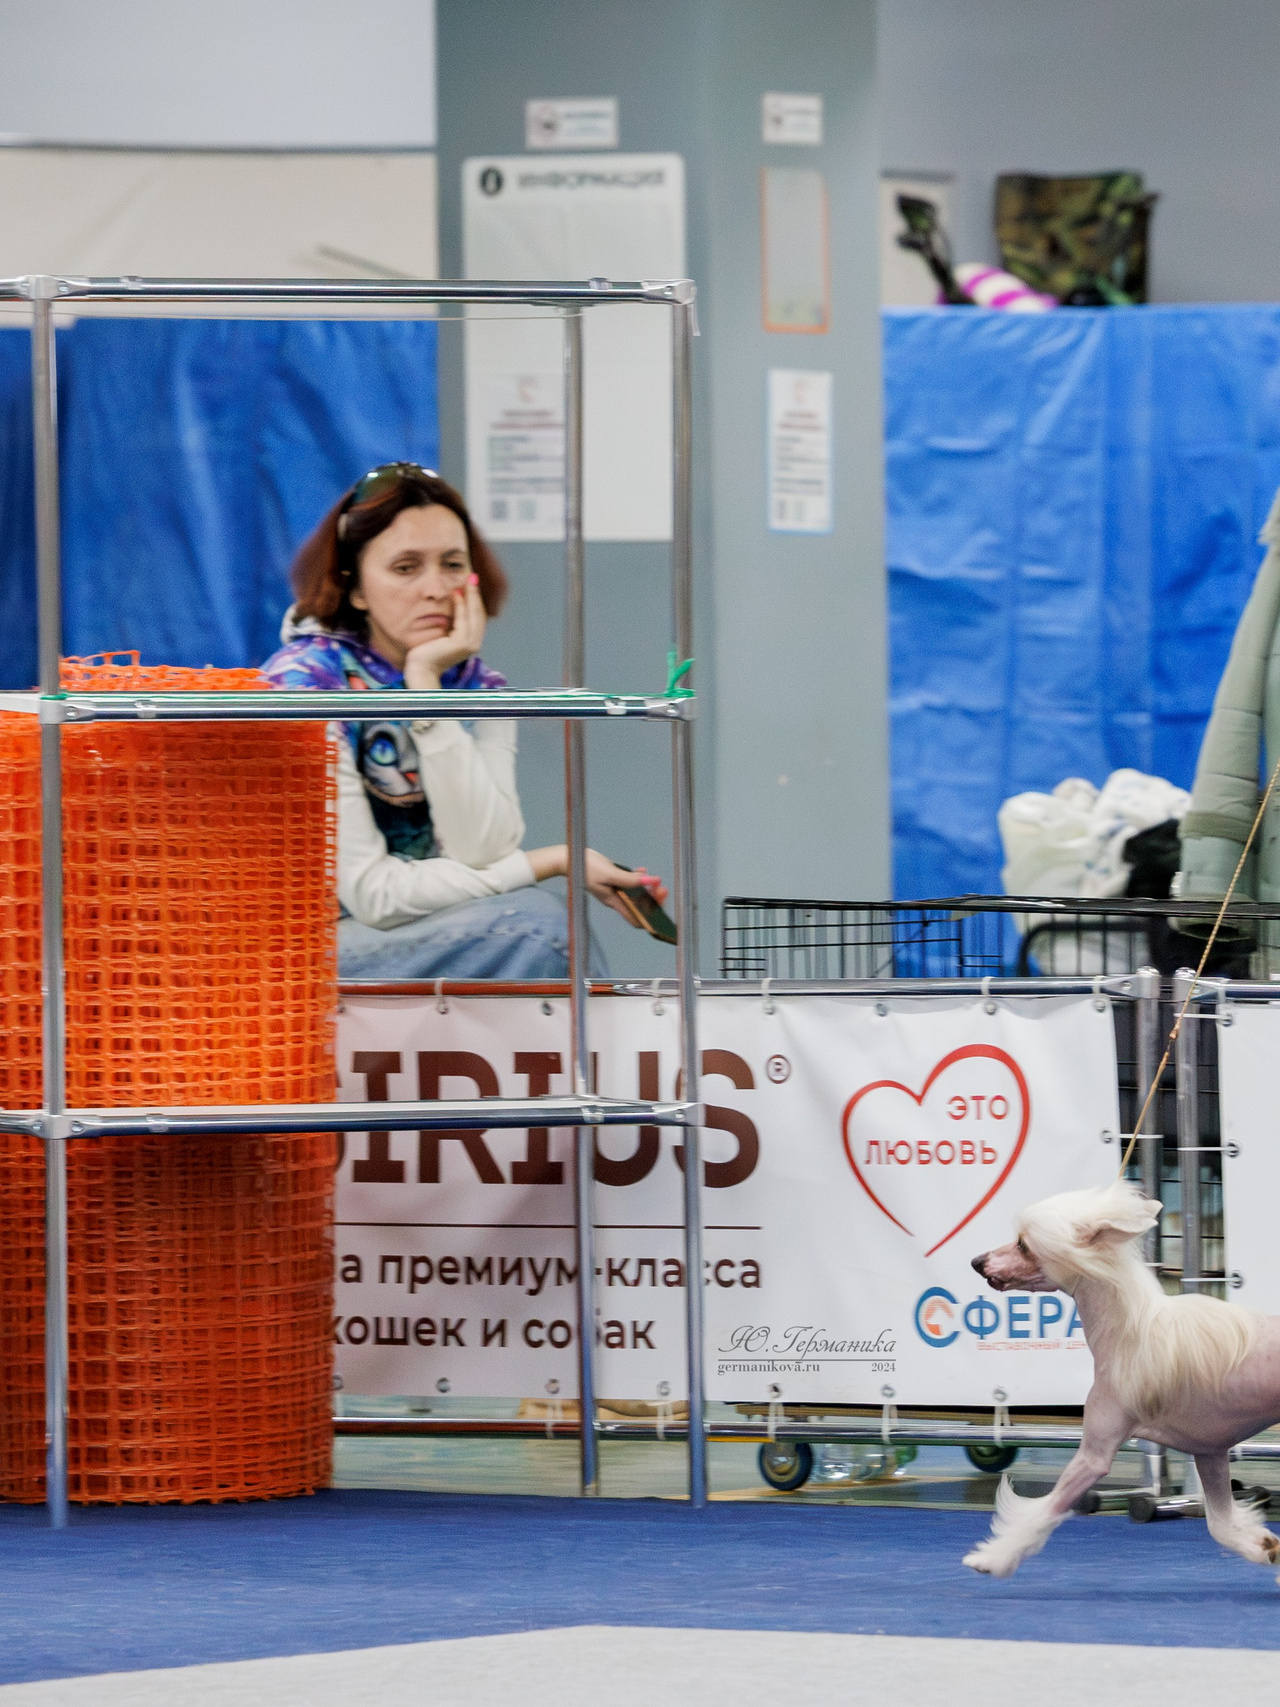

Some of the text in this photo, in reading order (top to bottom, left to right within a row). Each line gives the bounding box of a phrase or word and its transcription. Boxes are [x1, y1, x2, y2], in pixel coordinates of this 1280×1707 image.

[947, 1094, 1010, 1121] ЭТО
[864, 1140, 998, 1166] ЛЮБОВЬ
[378, 1254, 762, 1296] премиум-класа
[481, 1318, 507, 1348] и
[523, 1318, 657, 1350] соак
